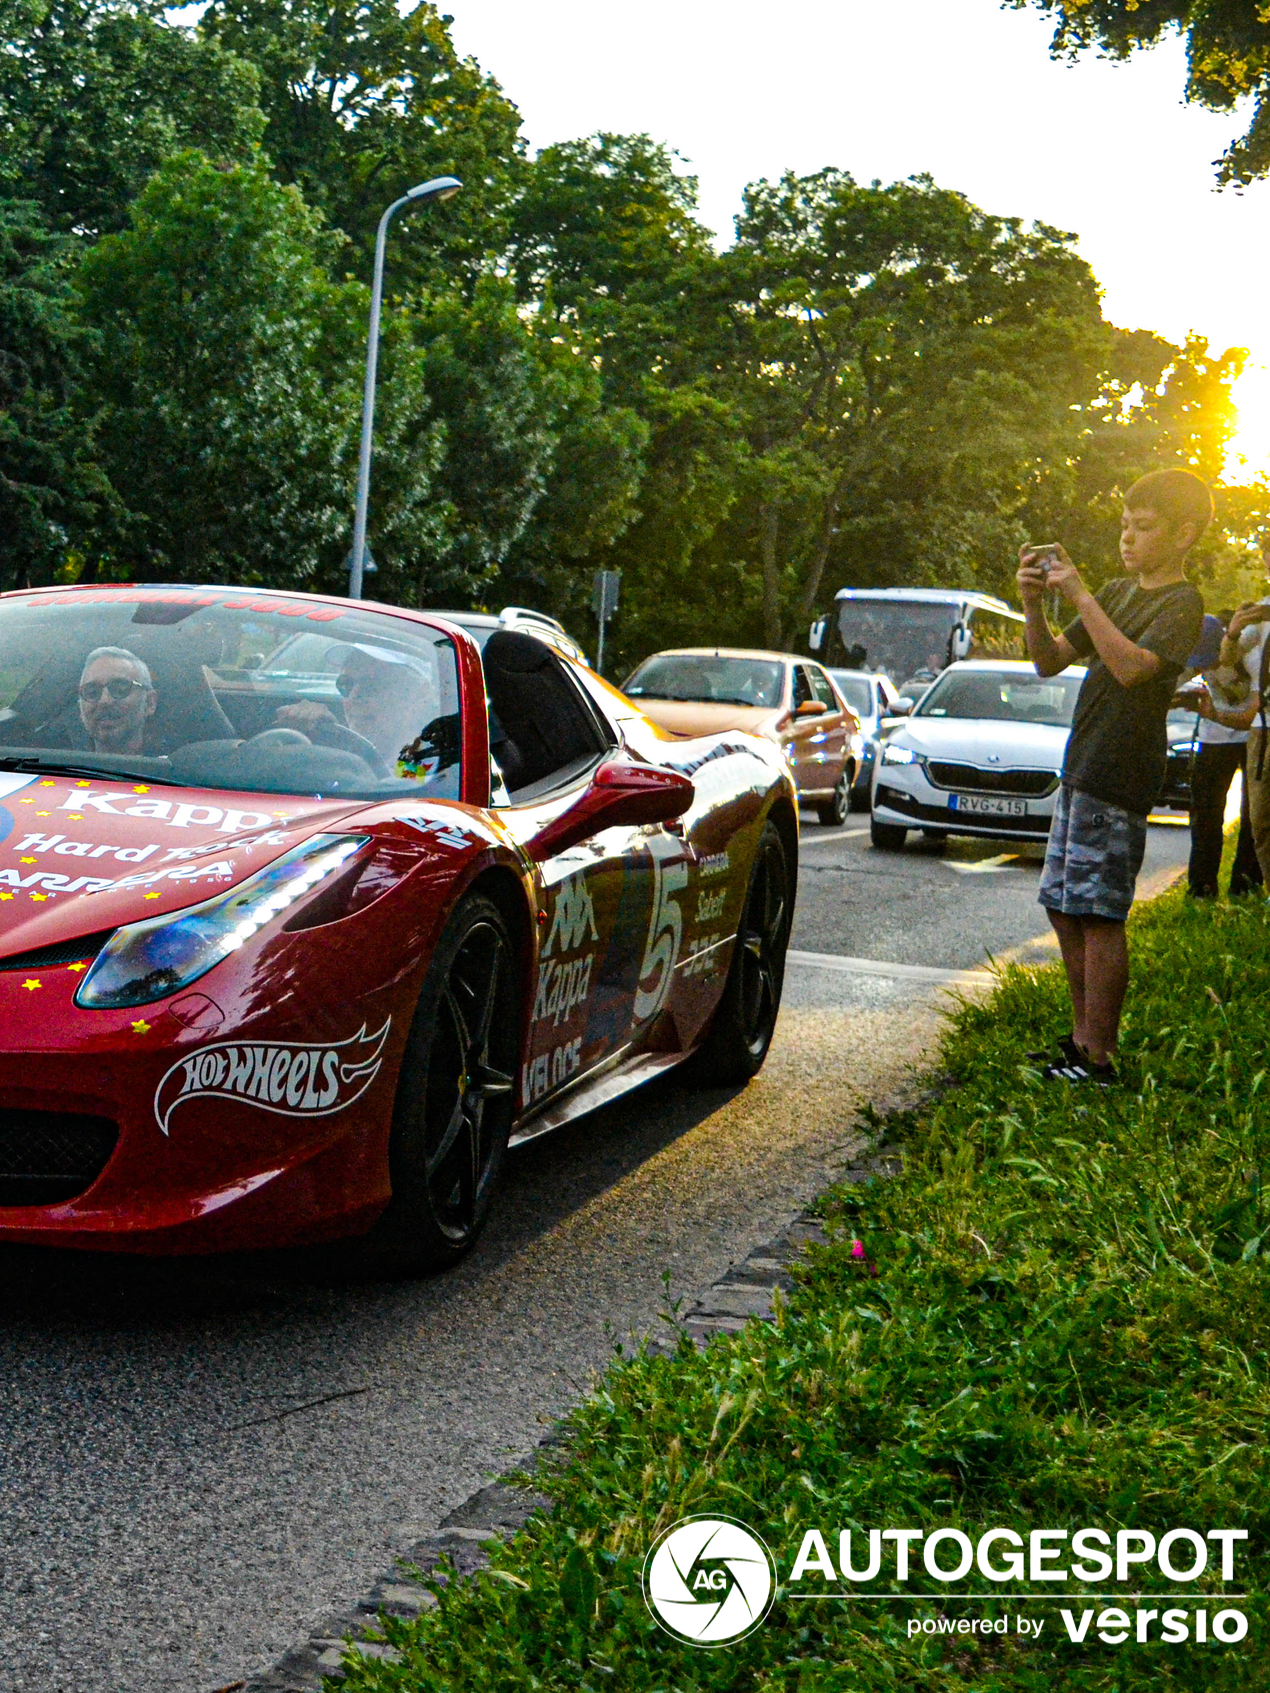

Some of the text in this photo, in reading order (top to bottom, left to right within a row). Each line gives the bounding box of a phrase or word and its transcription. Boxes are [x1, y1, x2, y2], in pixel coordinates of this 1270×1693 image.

[223, 597, 347, 622] 3000
[57, 789, 298, 834] Kapp
[12, 829, 291, 862] Hard Rock
[633, 833, 688, 1022] 5
[531, 953, 593, 1027] Kappa
